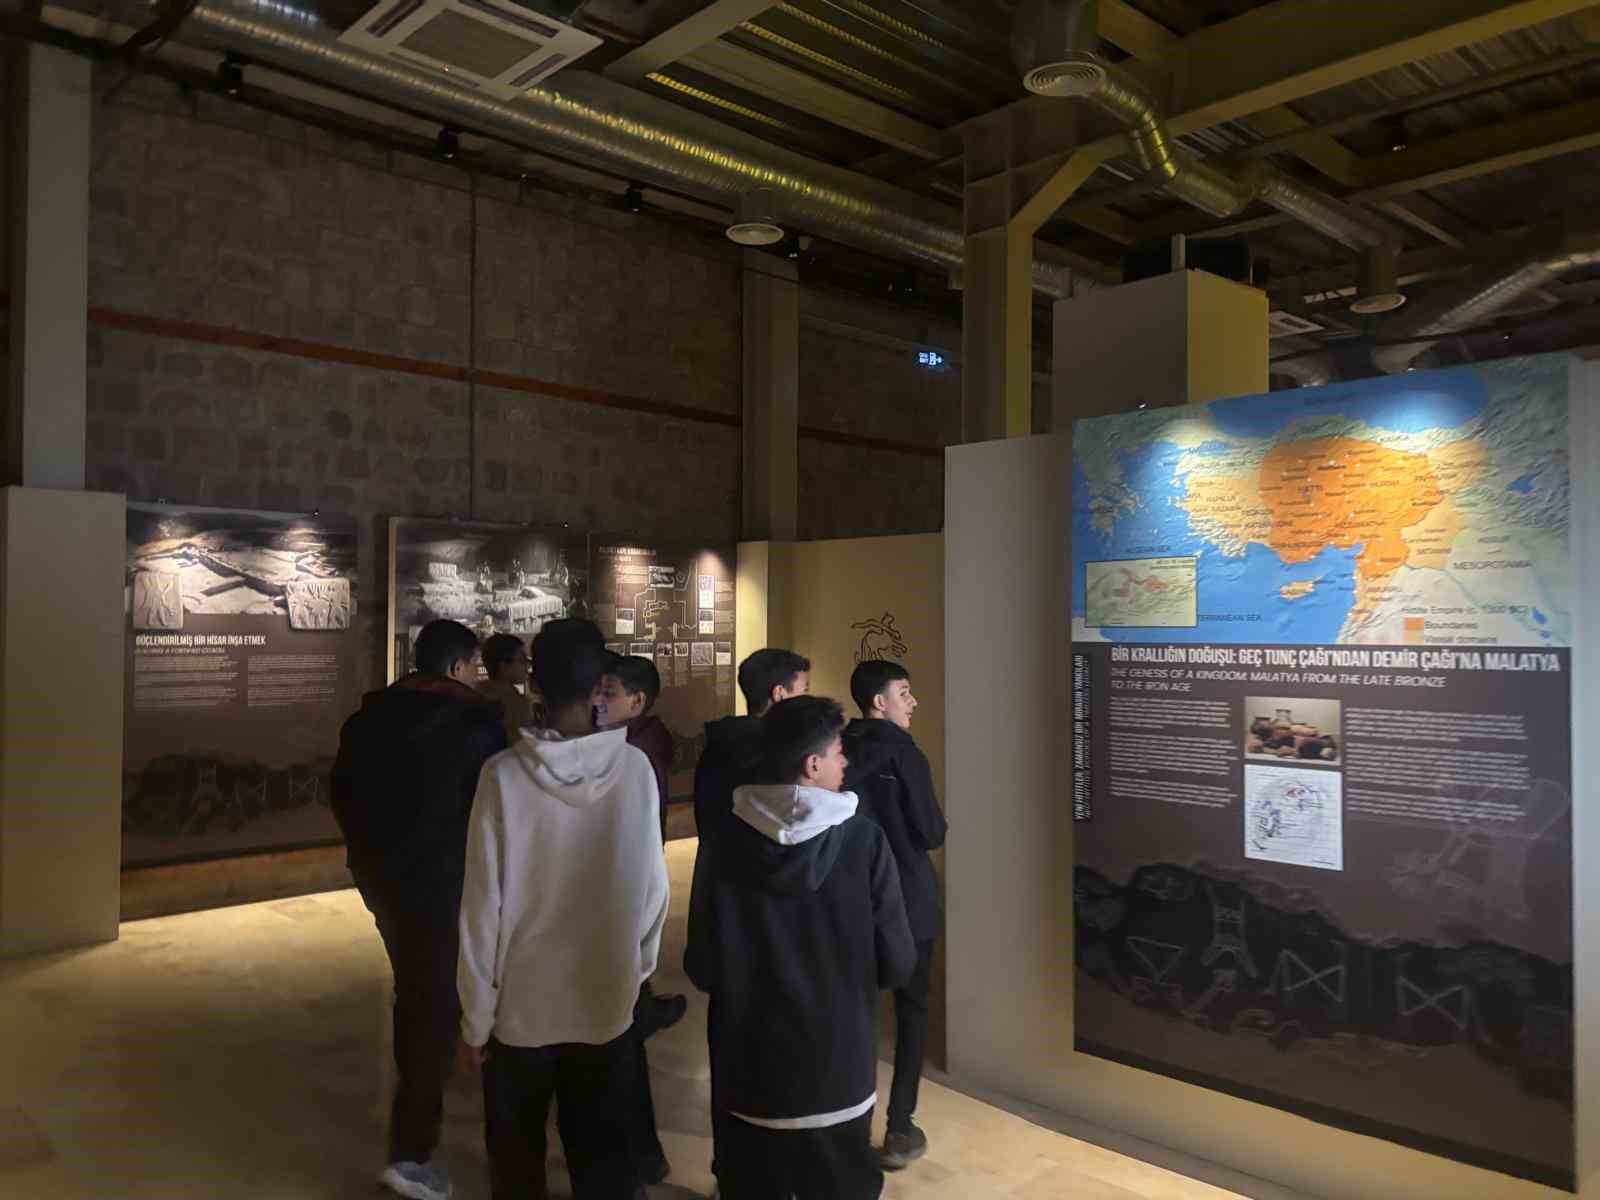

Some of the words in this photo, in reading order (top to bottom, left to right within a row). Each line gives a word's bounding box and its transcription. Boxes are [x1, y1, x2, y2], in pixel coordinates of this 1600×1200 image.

[1111, 645, 1128, 662] BİR
[1188, 646, 1238, 666] DOĞUŞU:
[1239, 648, 1262, 667] GEÇ
[1264, 649, 1296, 668] TUNÇ
[1372, 649, 1418, 668] DEMİR
[1484, 652, 1561, 672] MALATYA
[1169, 668, 1184, 679] OF
[1185, 669, 1193, 679] A
[1250, 671, 1300, 683] MALATYA
[1302, 672, 1337, 684] FROM
[1338, 673, 1361, 685] THE
[1363, 674, 1392, 686] LATE
[1394, 675, 1447, 688] BRONZE
